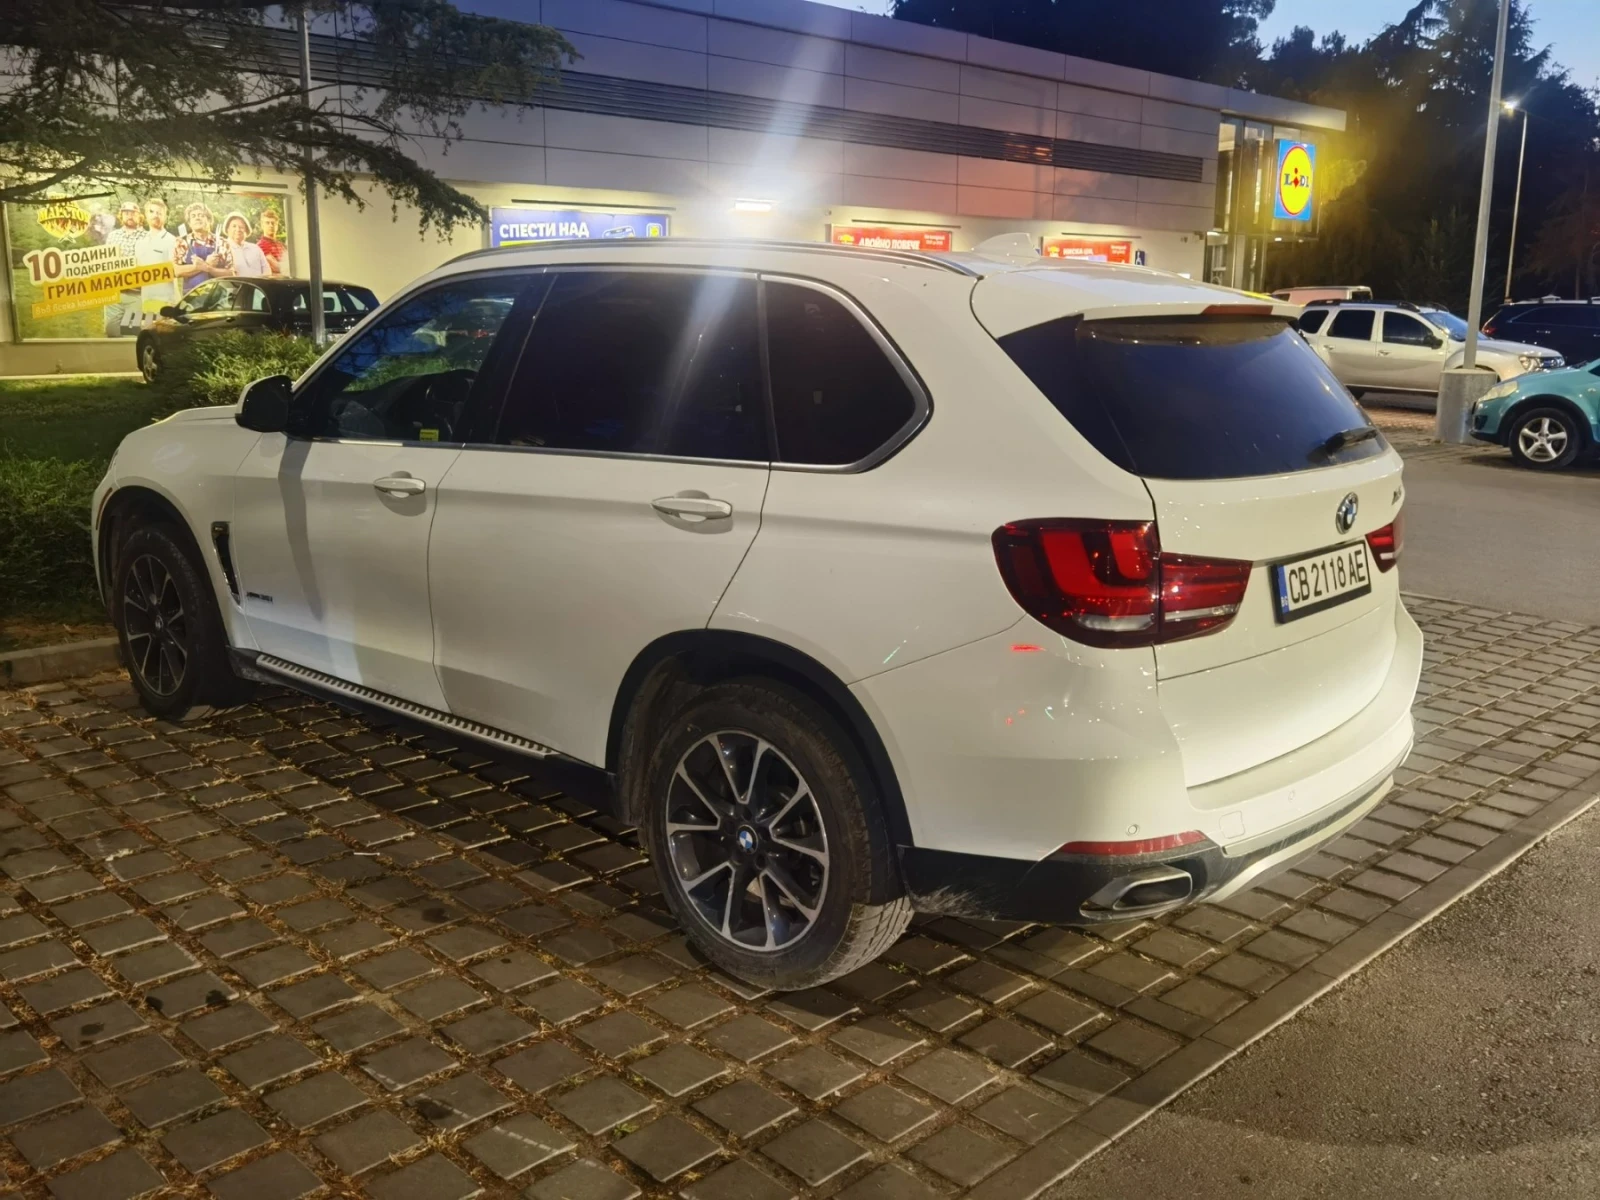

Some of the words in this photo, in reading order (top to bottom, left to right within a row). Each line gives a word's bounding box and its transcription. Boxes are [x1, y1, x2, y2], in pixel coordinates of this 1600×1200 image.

[499, 222, 556, 239] СПЕСТИ
[558, 221, 590, 239] НАД
[27, 251, 62, 282] 10
[65, 246, 117, 265] ГОДИНИ
[66, 257, 135, 278] ПОДКРЕПЯМЕ
[47, 282, 87, 300] ГРИЛ
[90, 266, 171, 293] МАЙСТОРА
[1288, 566, 1310, 604] CB
[1311, 555, 1347, 598] 2118
[1348, 549, 1366, 586] AE
